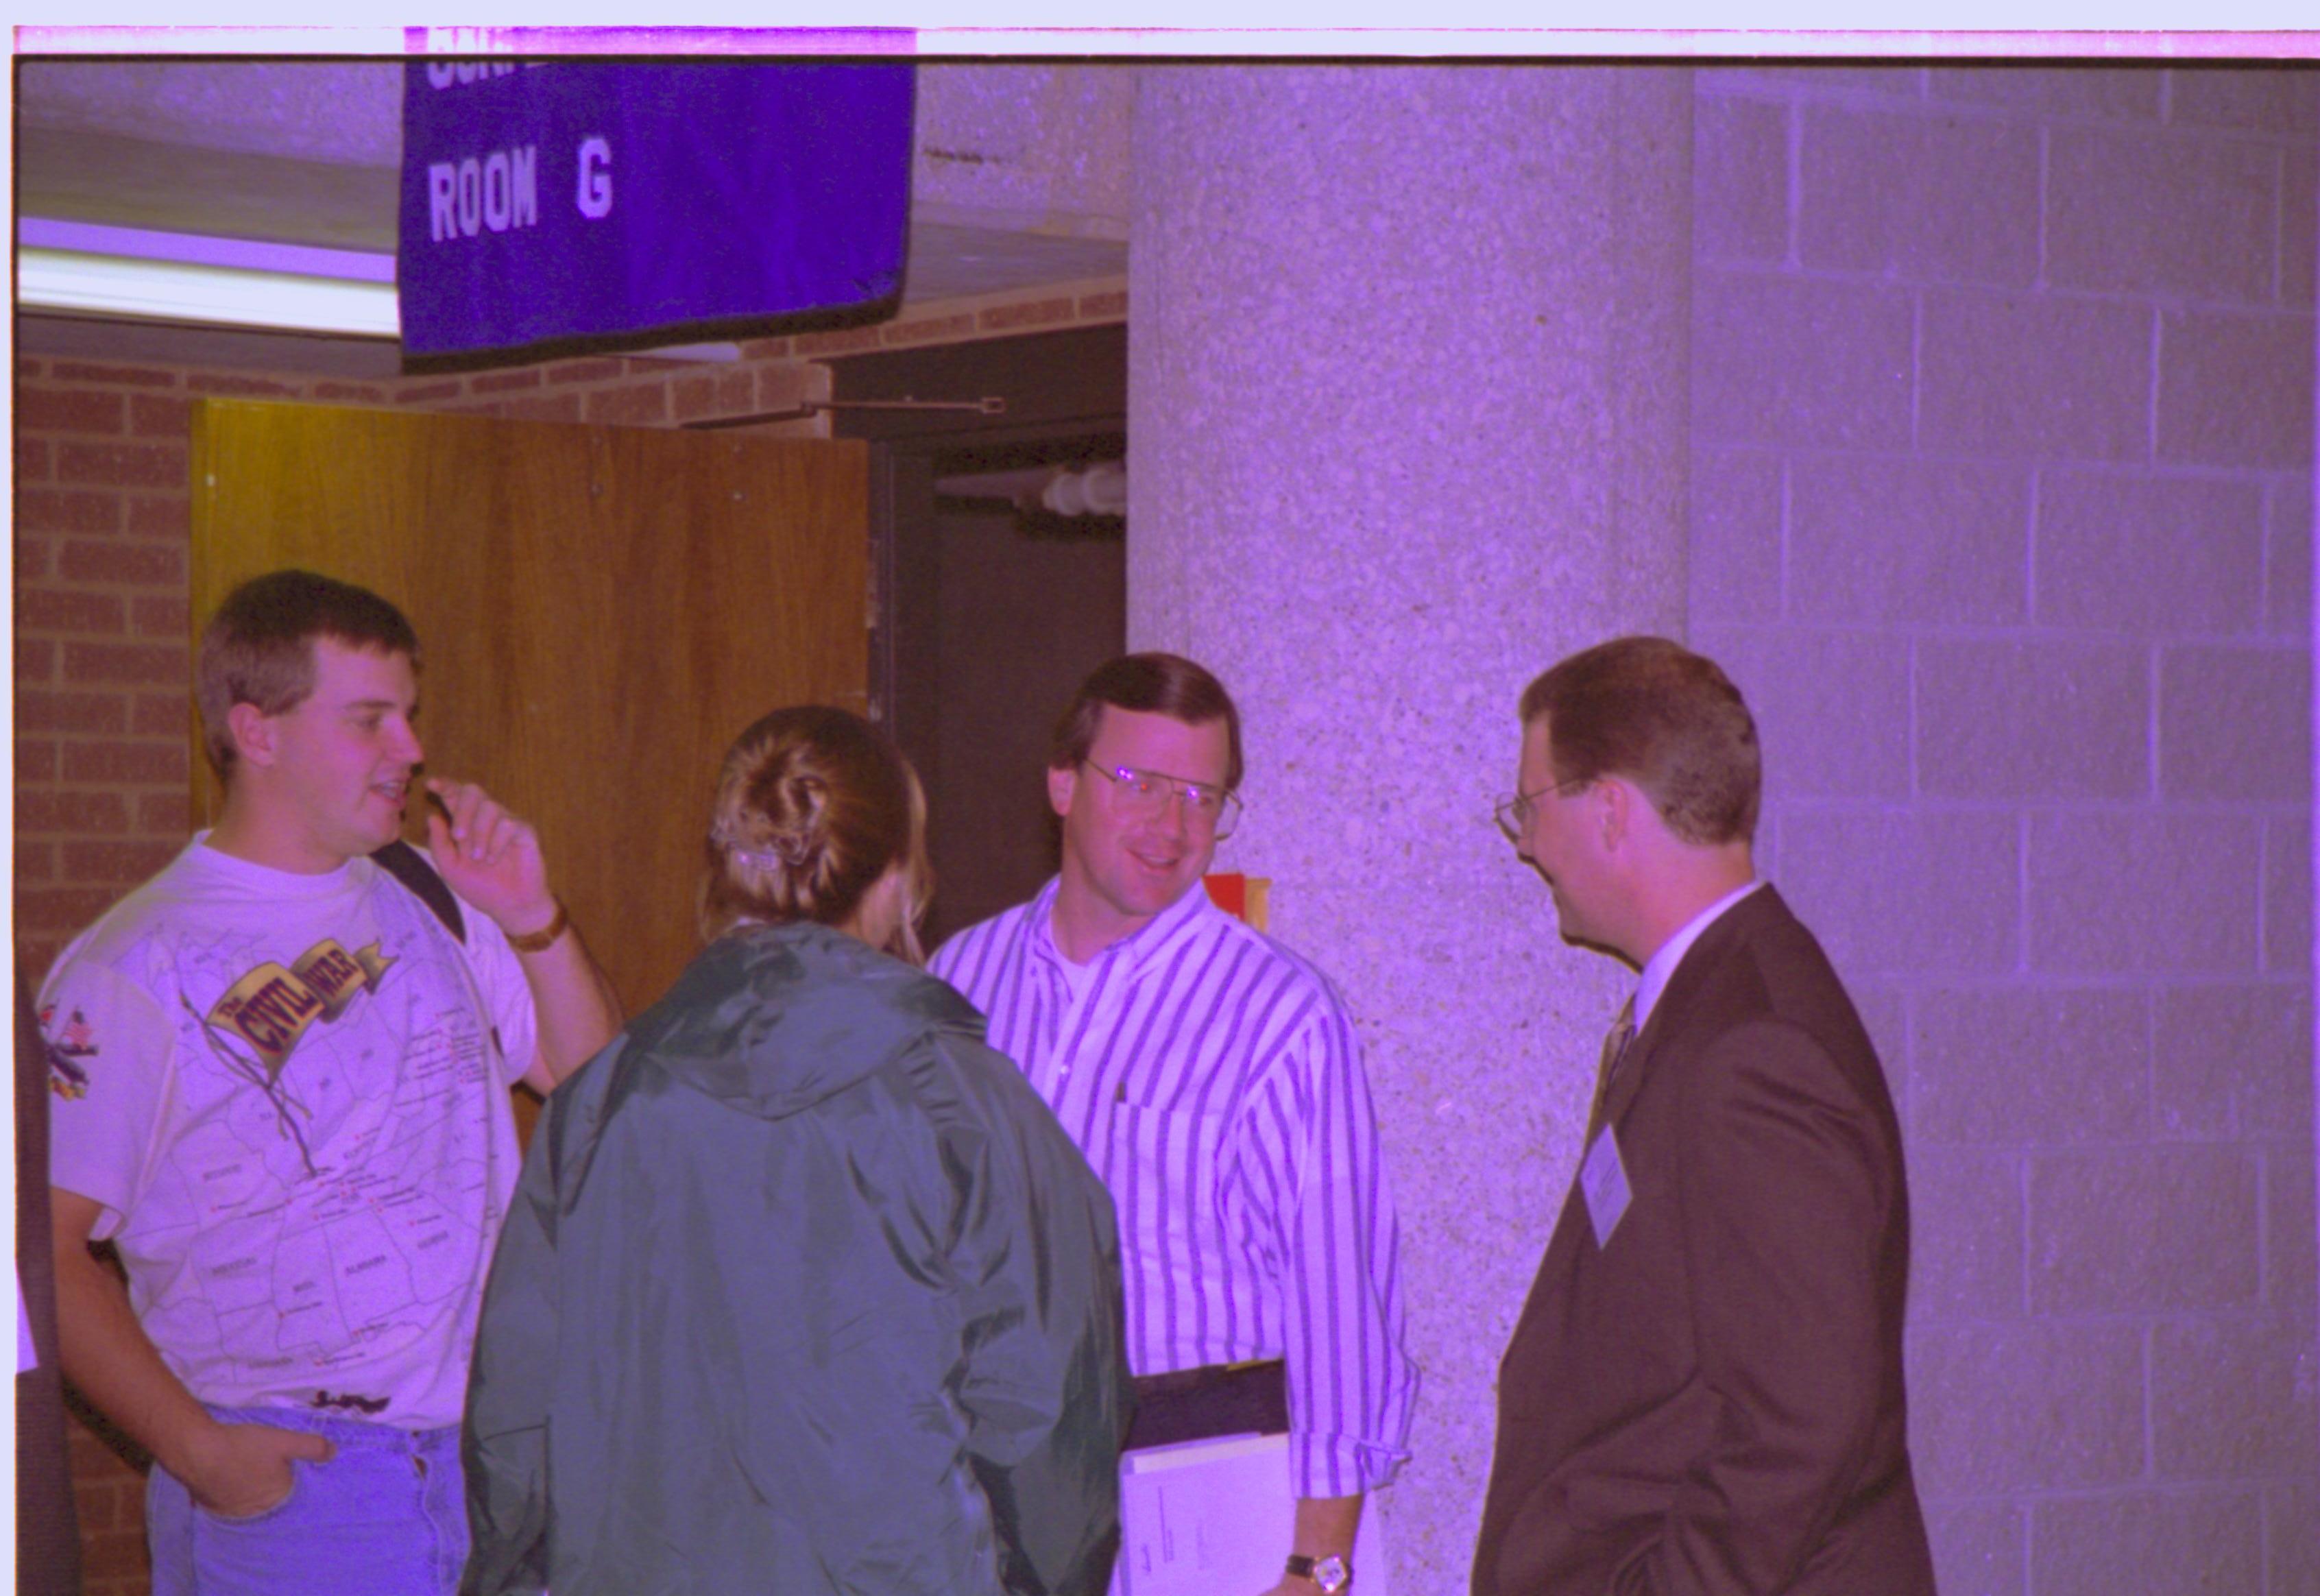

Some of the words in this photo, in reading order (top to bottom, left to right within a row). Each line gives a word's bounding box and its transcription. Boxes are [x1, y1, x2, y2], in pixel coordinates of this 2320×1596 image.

[429, 145, 537, 241] ROOM
[578, 138, 612, 219] G
[234, 976, 319, 1053] CIVIL
[304, 949, 359, 998] WAR
